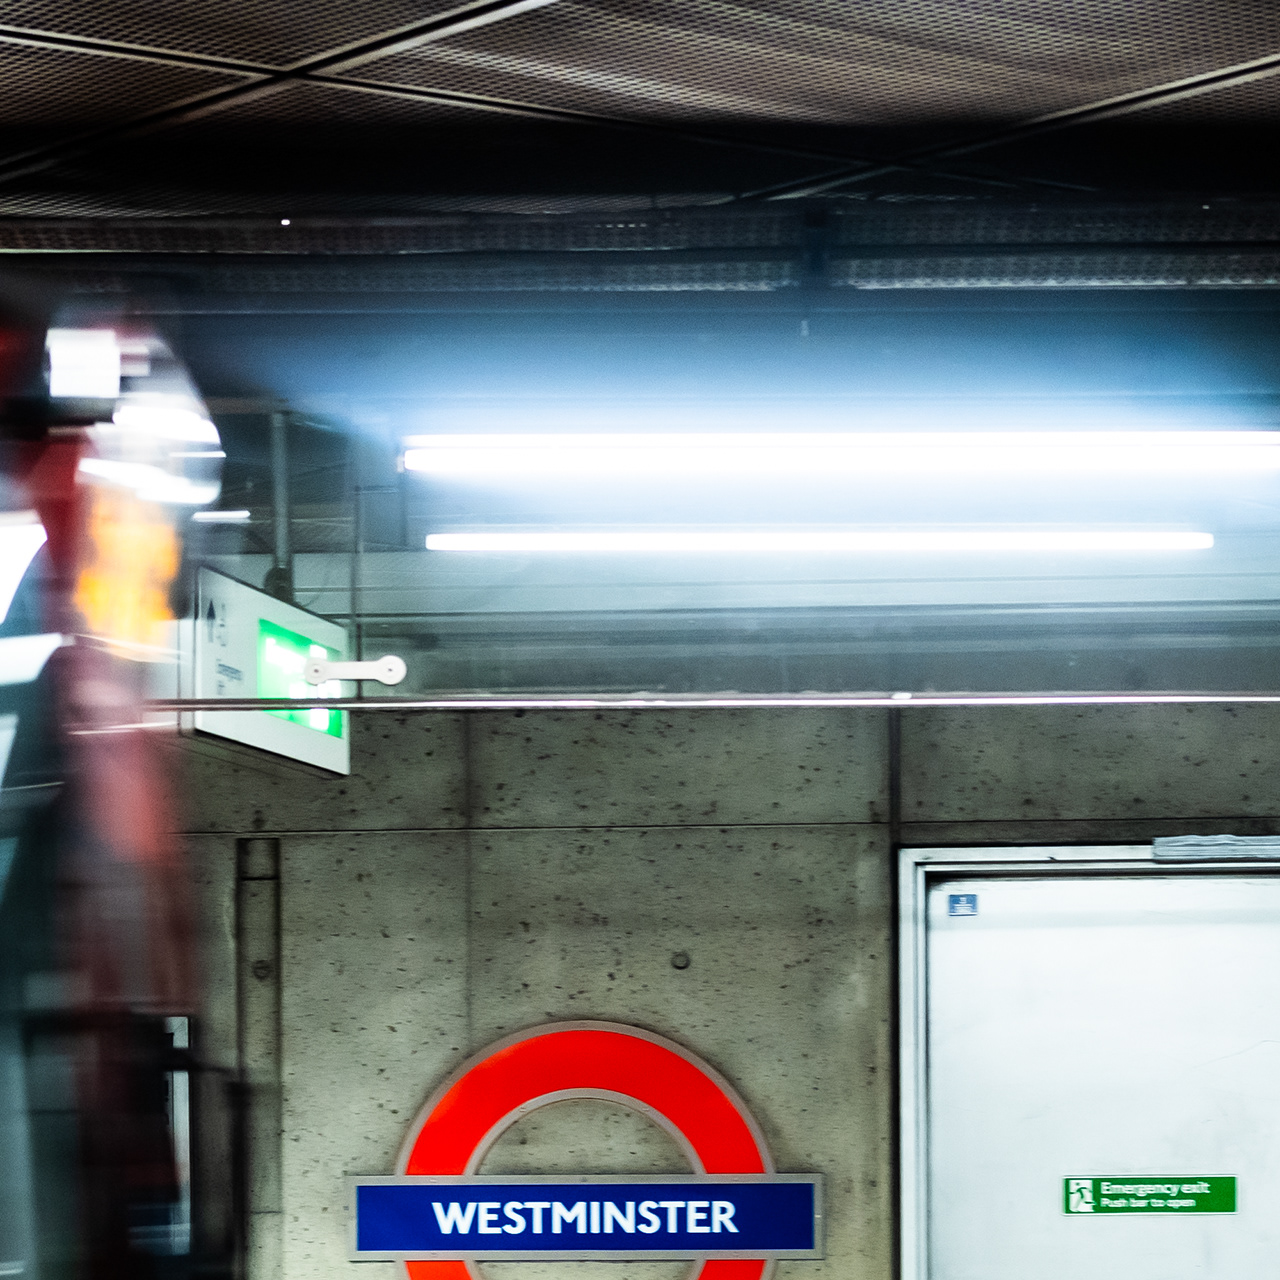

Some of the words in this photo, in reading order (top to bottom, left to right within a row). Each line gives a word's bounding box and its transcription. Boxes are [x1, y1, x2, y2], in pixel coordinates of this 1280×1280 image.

[1101, 1181, 1180, 1196] Emergency
[1180, 1181, 1211, 1194] exit
[1101, 1197, 1128, 1207] Push
[1129, 1197, 1149, 1207] bar
[1150, 1199, 1165, 1207] to
[1166, 1199, 1196, 1209] open
[431, 1200, 740, 1235] WESTMINSTER
